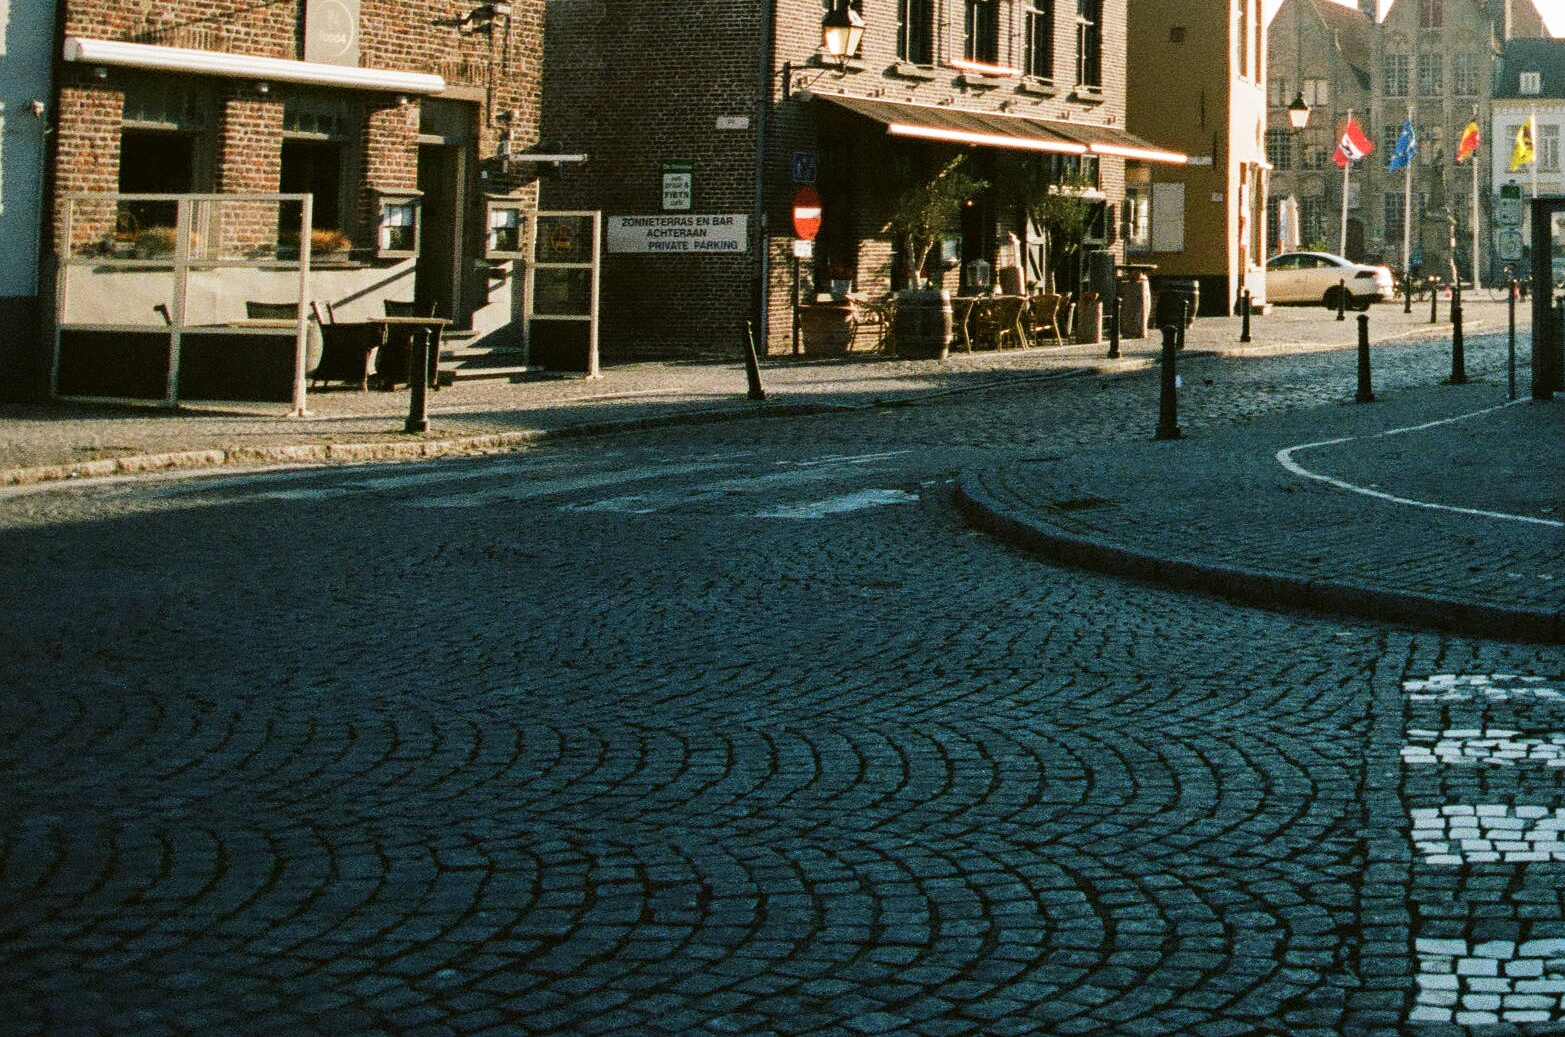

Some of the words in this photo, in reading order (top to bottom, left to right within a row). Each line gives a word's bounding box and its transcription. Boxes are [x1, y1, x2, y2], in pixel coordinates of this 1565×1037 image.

[621, 216, 693, 227] ZONNETERRAS
[696, 217, 709, 225] EN
[712, 216, 733, 225] BAR
[646, 228, 707, 238] ACHTERAAN
[648, 241, 689, 250] PRIVATE
[693, 241, 739, 250] PARKING
